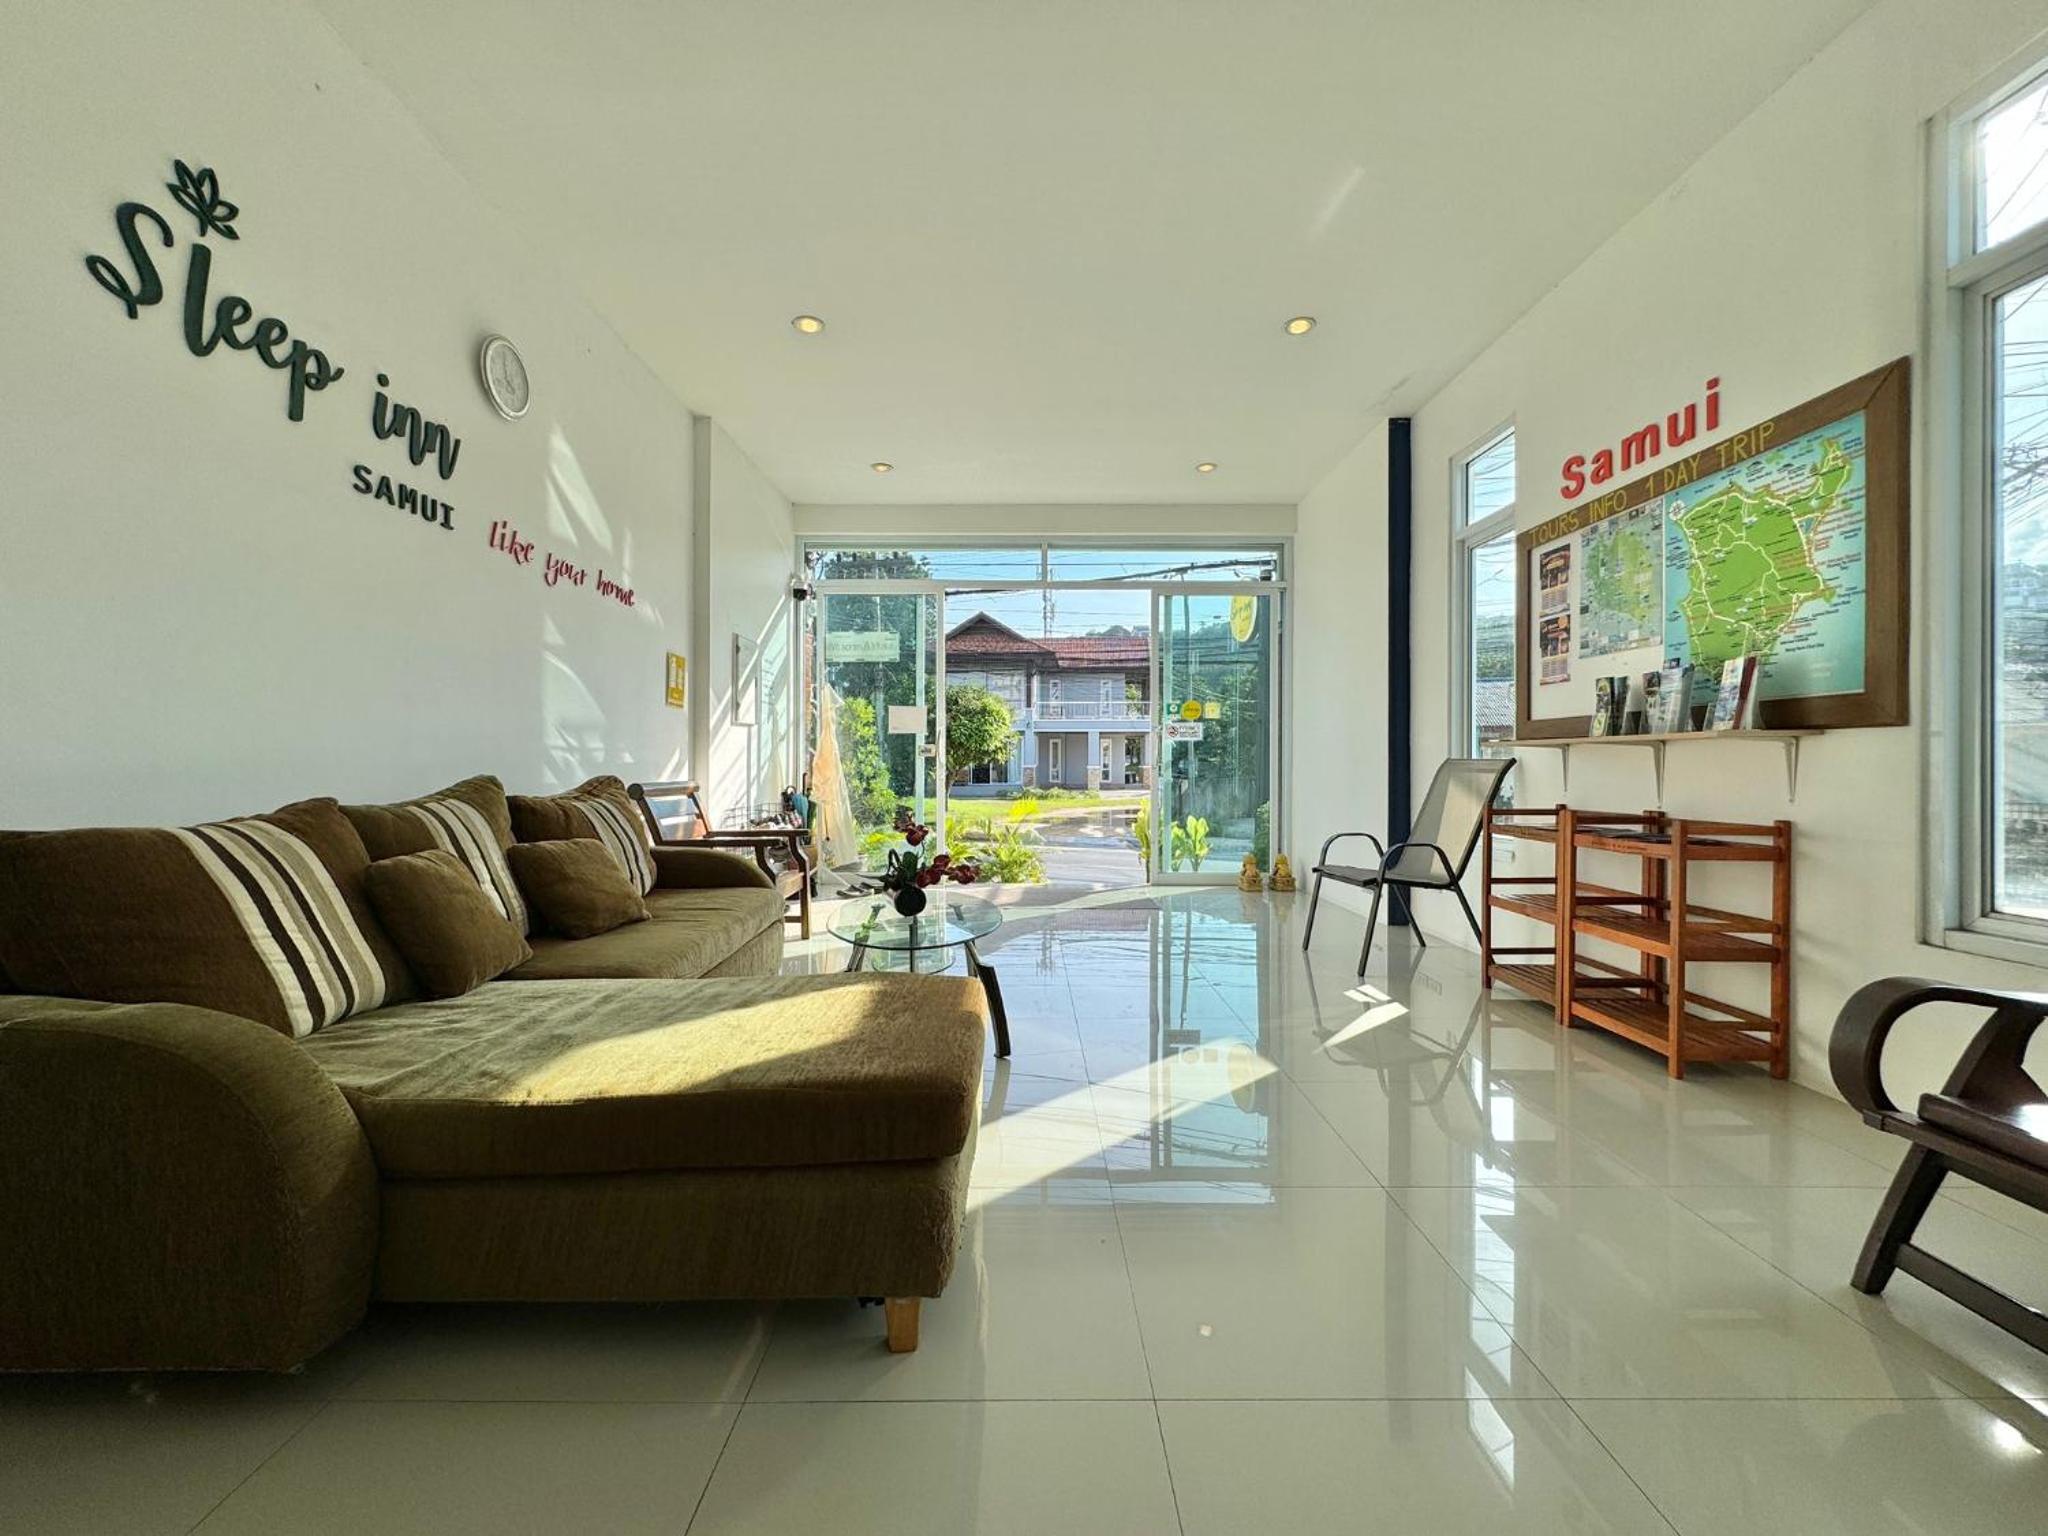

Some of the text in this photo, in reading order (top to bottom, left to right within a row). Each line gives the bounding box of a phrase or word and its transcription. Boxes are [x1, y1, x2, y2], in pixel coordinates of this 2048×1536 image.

[85, 202, 461, 480] Sleep inn
[353, 464, 455, 530] SAMUI
[1529, 510, 1580, 546] TOURS
[1589, 489, 1627, 522] INFO
[1645, 476, 1655, 498] 1
[1664, 453, 1701, 492] DAY
[1715, 421, 1775, 469] TRIP
[489, 520, 635, 607] like your home
